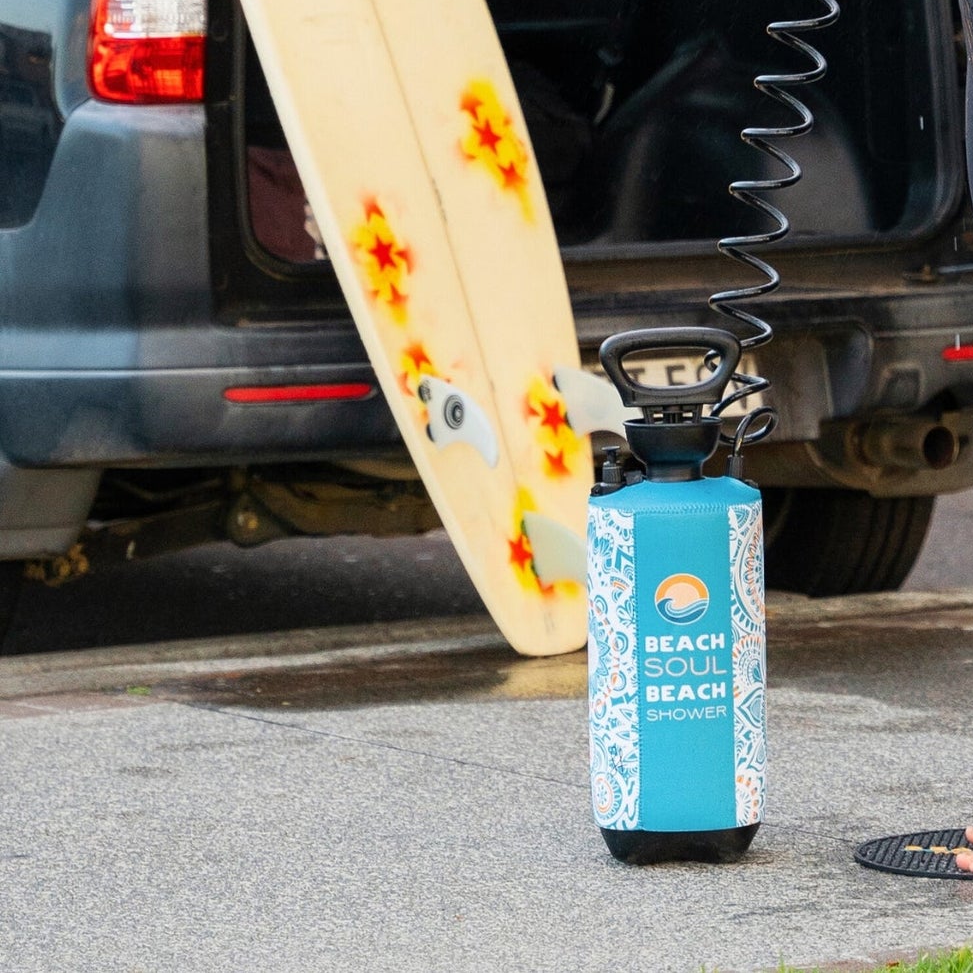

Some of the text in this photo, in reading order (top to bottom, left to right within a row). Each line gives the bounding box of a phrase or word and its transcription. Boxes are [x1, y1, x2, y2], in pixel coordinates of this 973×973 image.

[645, 633, 725, 653] BEACH
[644, 656, 727, 678] SOUL
[646, 682, 726, 703] BEACH
[646, 705, 727, 722] SHOWER
